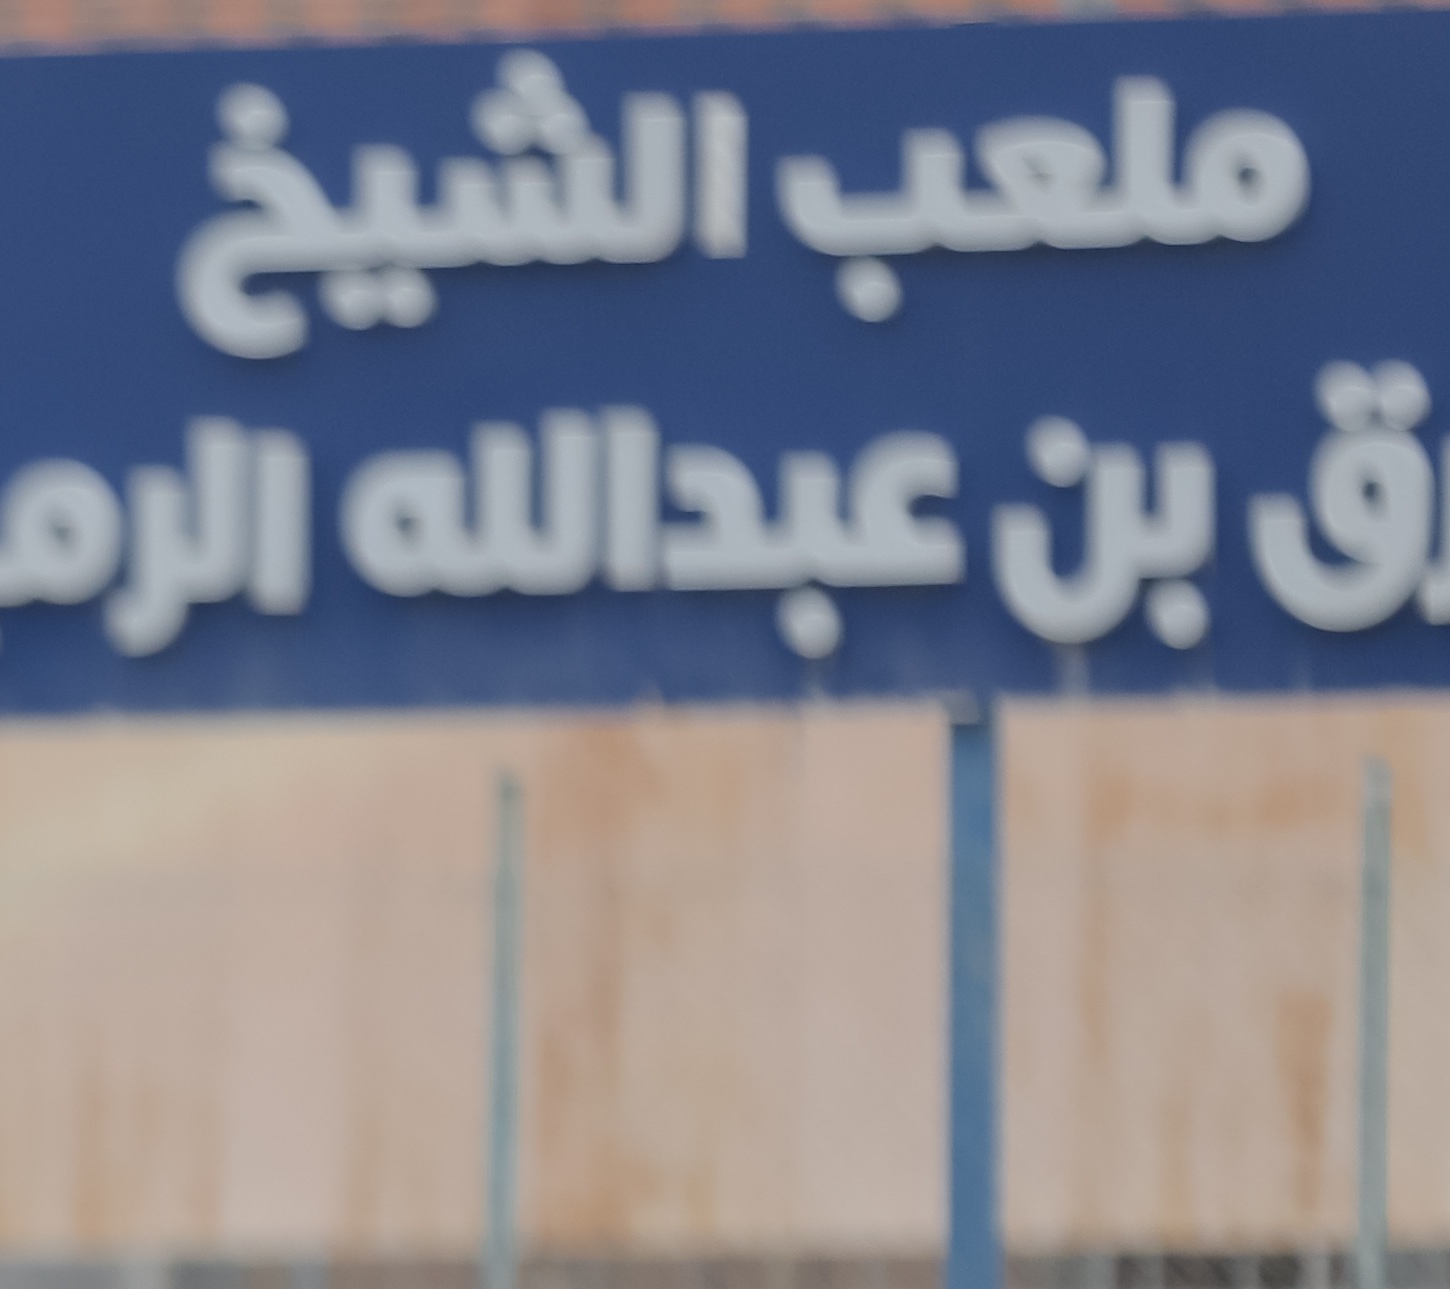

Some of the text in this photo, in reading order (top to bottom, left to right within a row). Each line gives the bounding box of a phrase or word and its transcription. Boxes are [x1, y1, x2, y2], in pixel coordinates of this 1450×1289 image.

[176, 49, 1312, 359] ملعب الشيخ
[340, 405, 965, 659] عبدالله
[992, 415, 1215, 649] بن
